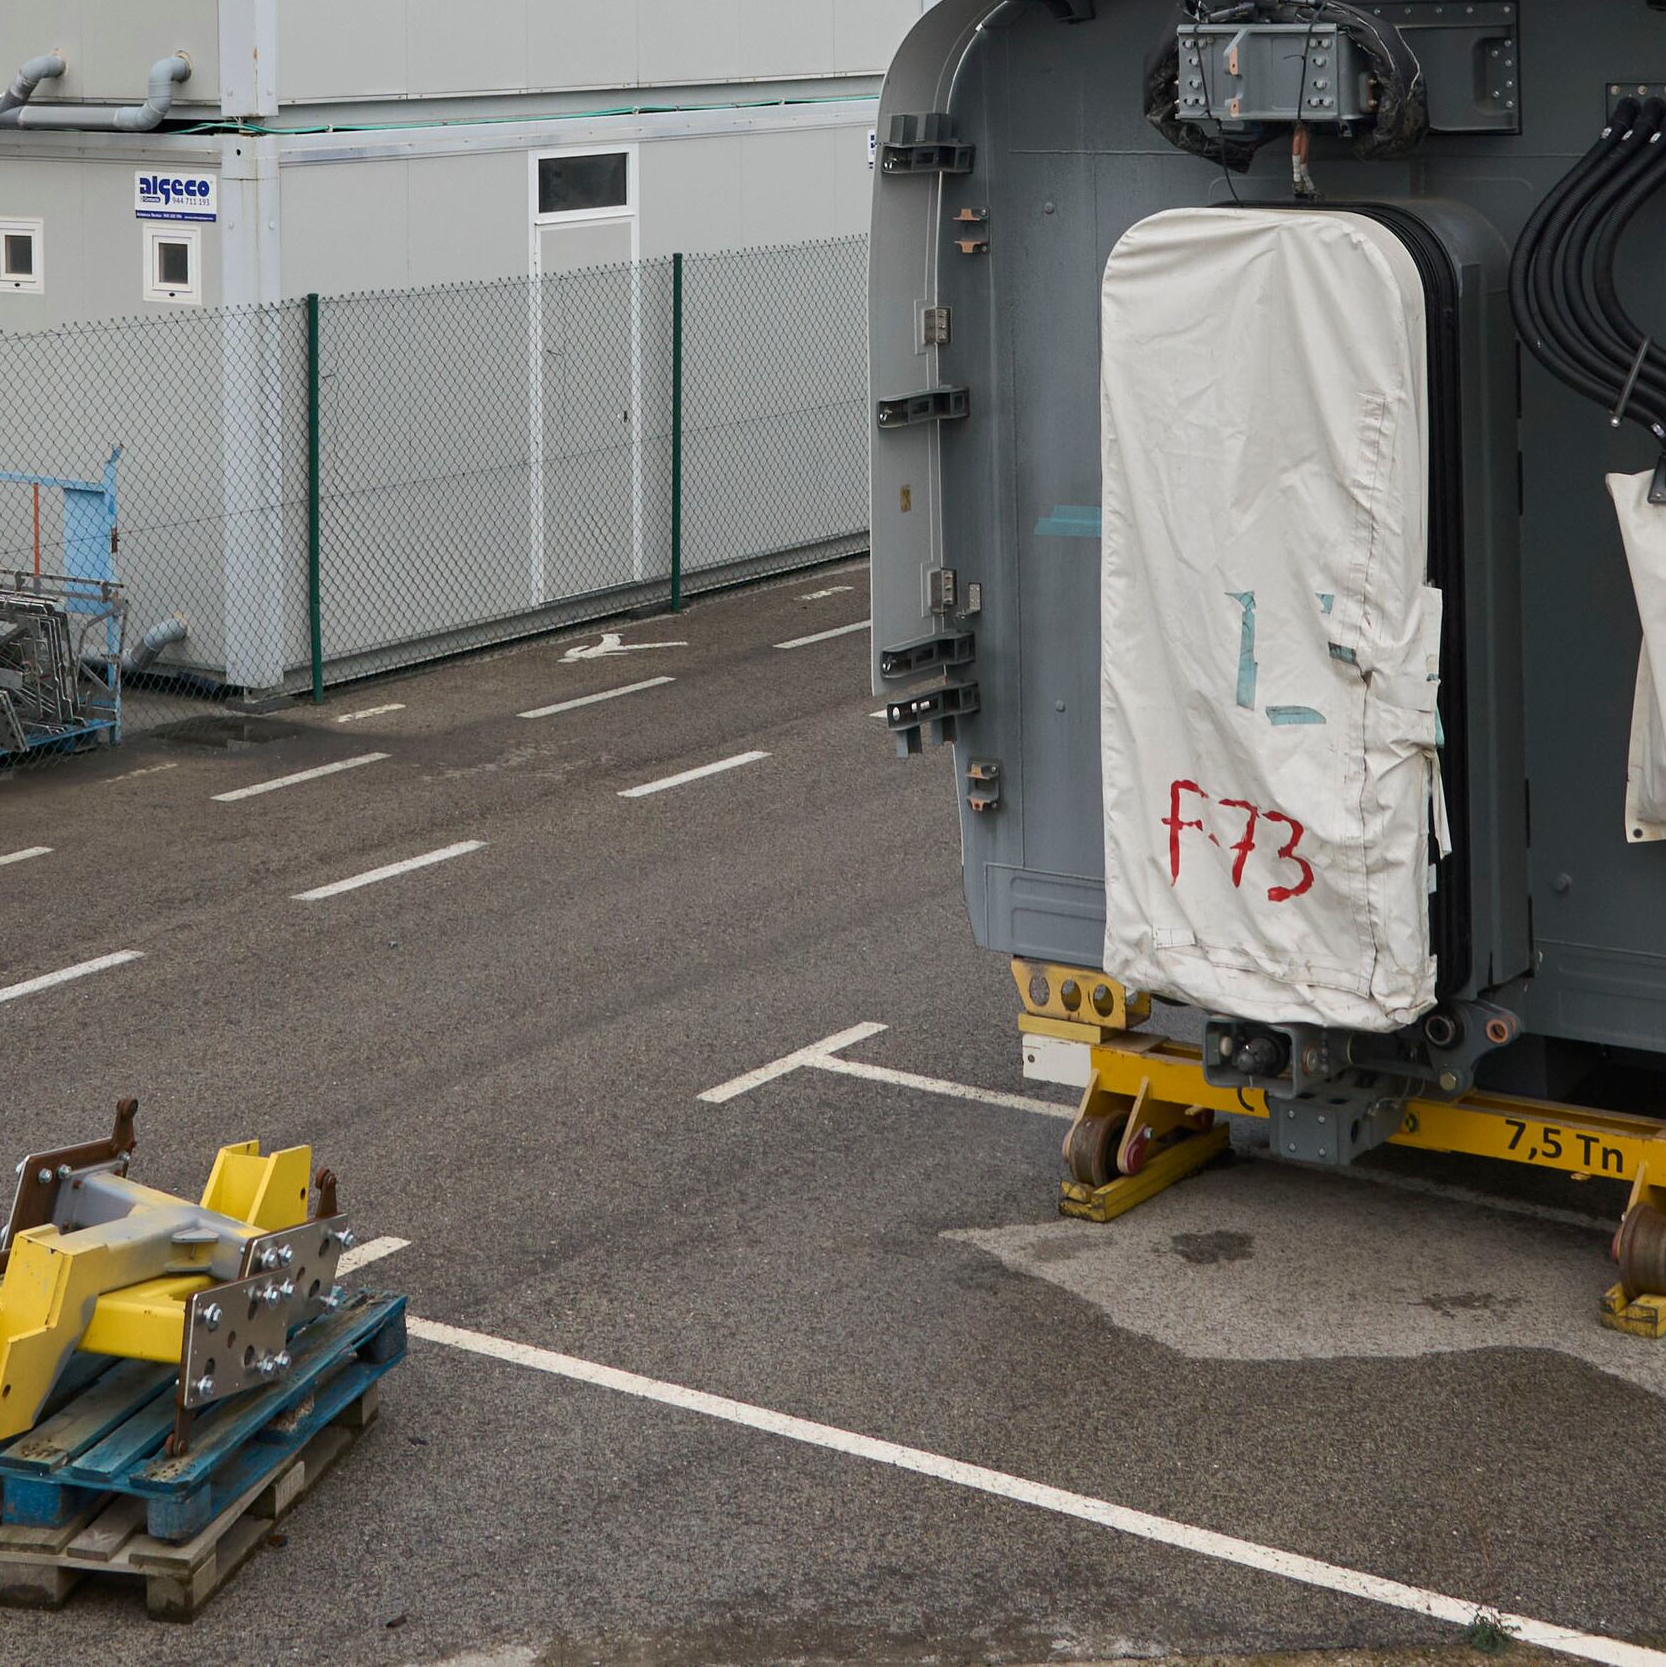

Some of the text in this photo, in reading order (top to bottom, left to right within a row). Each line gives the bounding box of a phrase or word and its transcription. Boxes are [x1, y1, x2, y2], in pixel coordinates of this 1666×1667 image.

[139, 176, 210, 205] algeco
[1505, 1118, 1624, 1174] 7,5 Tn
